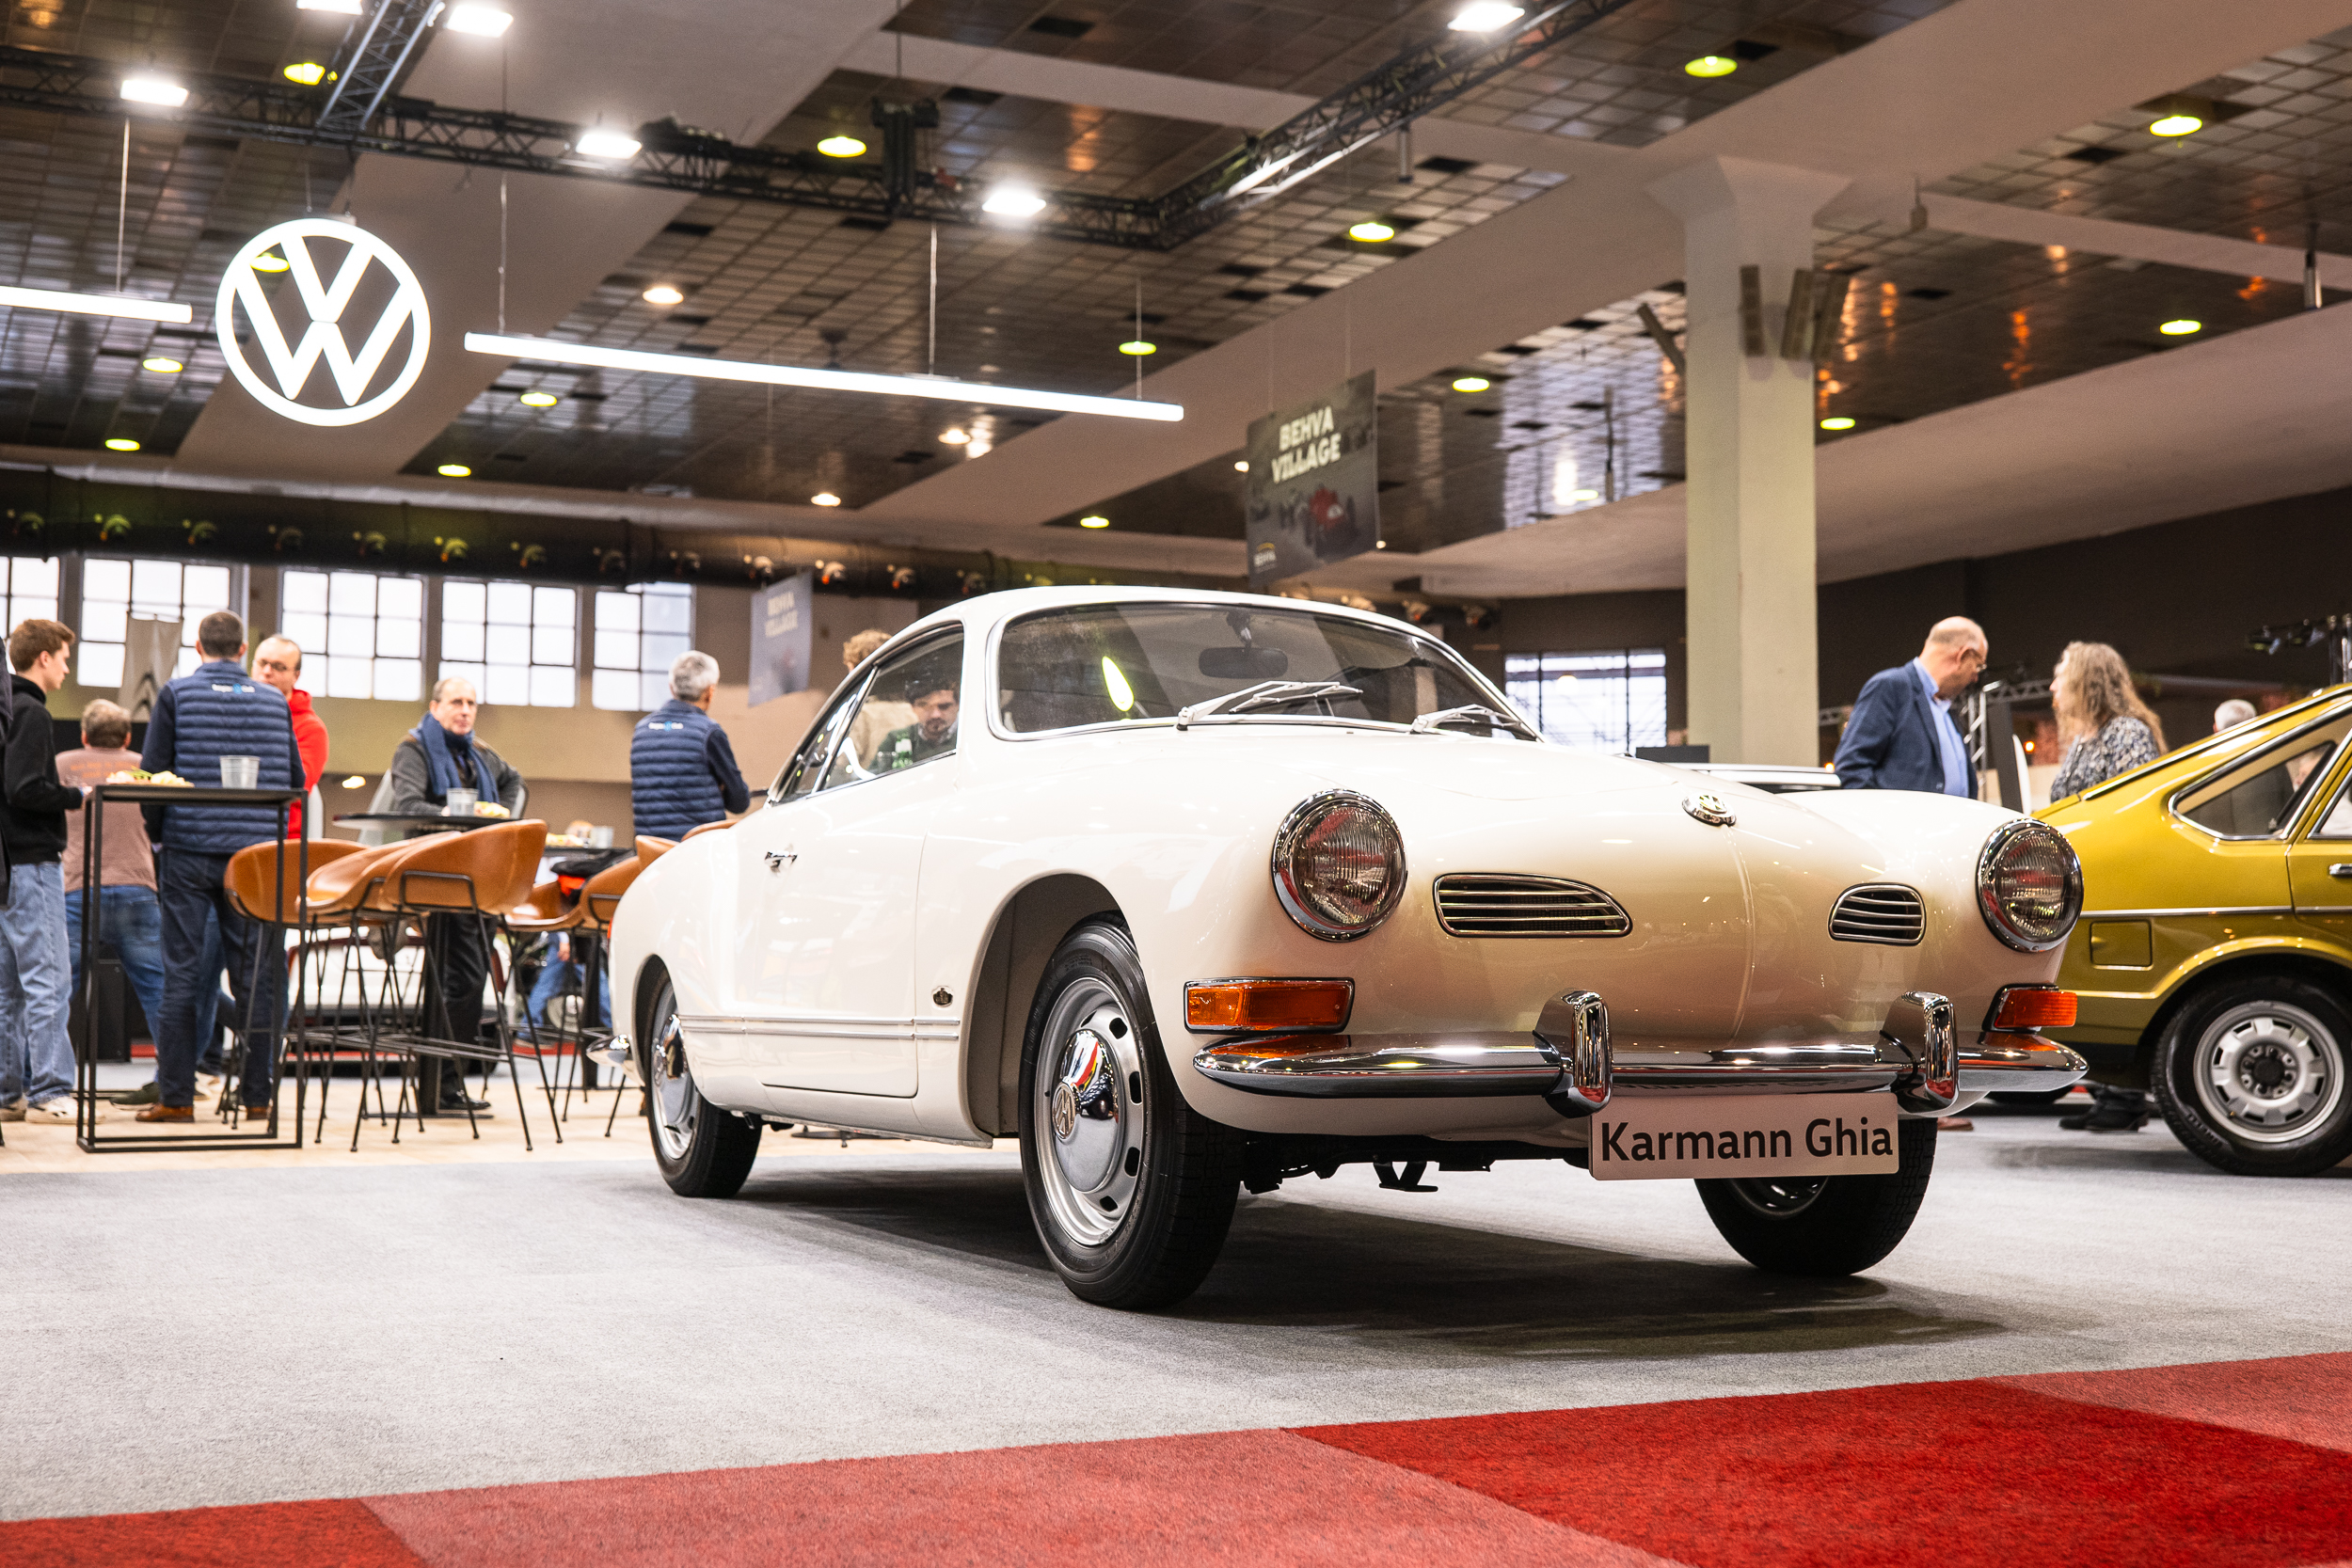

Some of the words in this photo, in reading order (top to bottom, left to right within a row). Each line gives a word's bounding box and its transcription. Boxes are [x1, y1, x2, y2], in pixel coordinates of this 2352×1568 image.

[1279, 405, 1334, 451] BEHVA
[1271, 433, 1342, 484] VILLAGE
[1601, 1121, 1792, 1162] Karmann
[1805, 1117, 1894, 1158] Ghia
